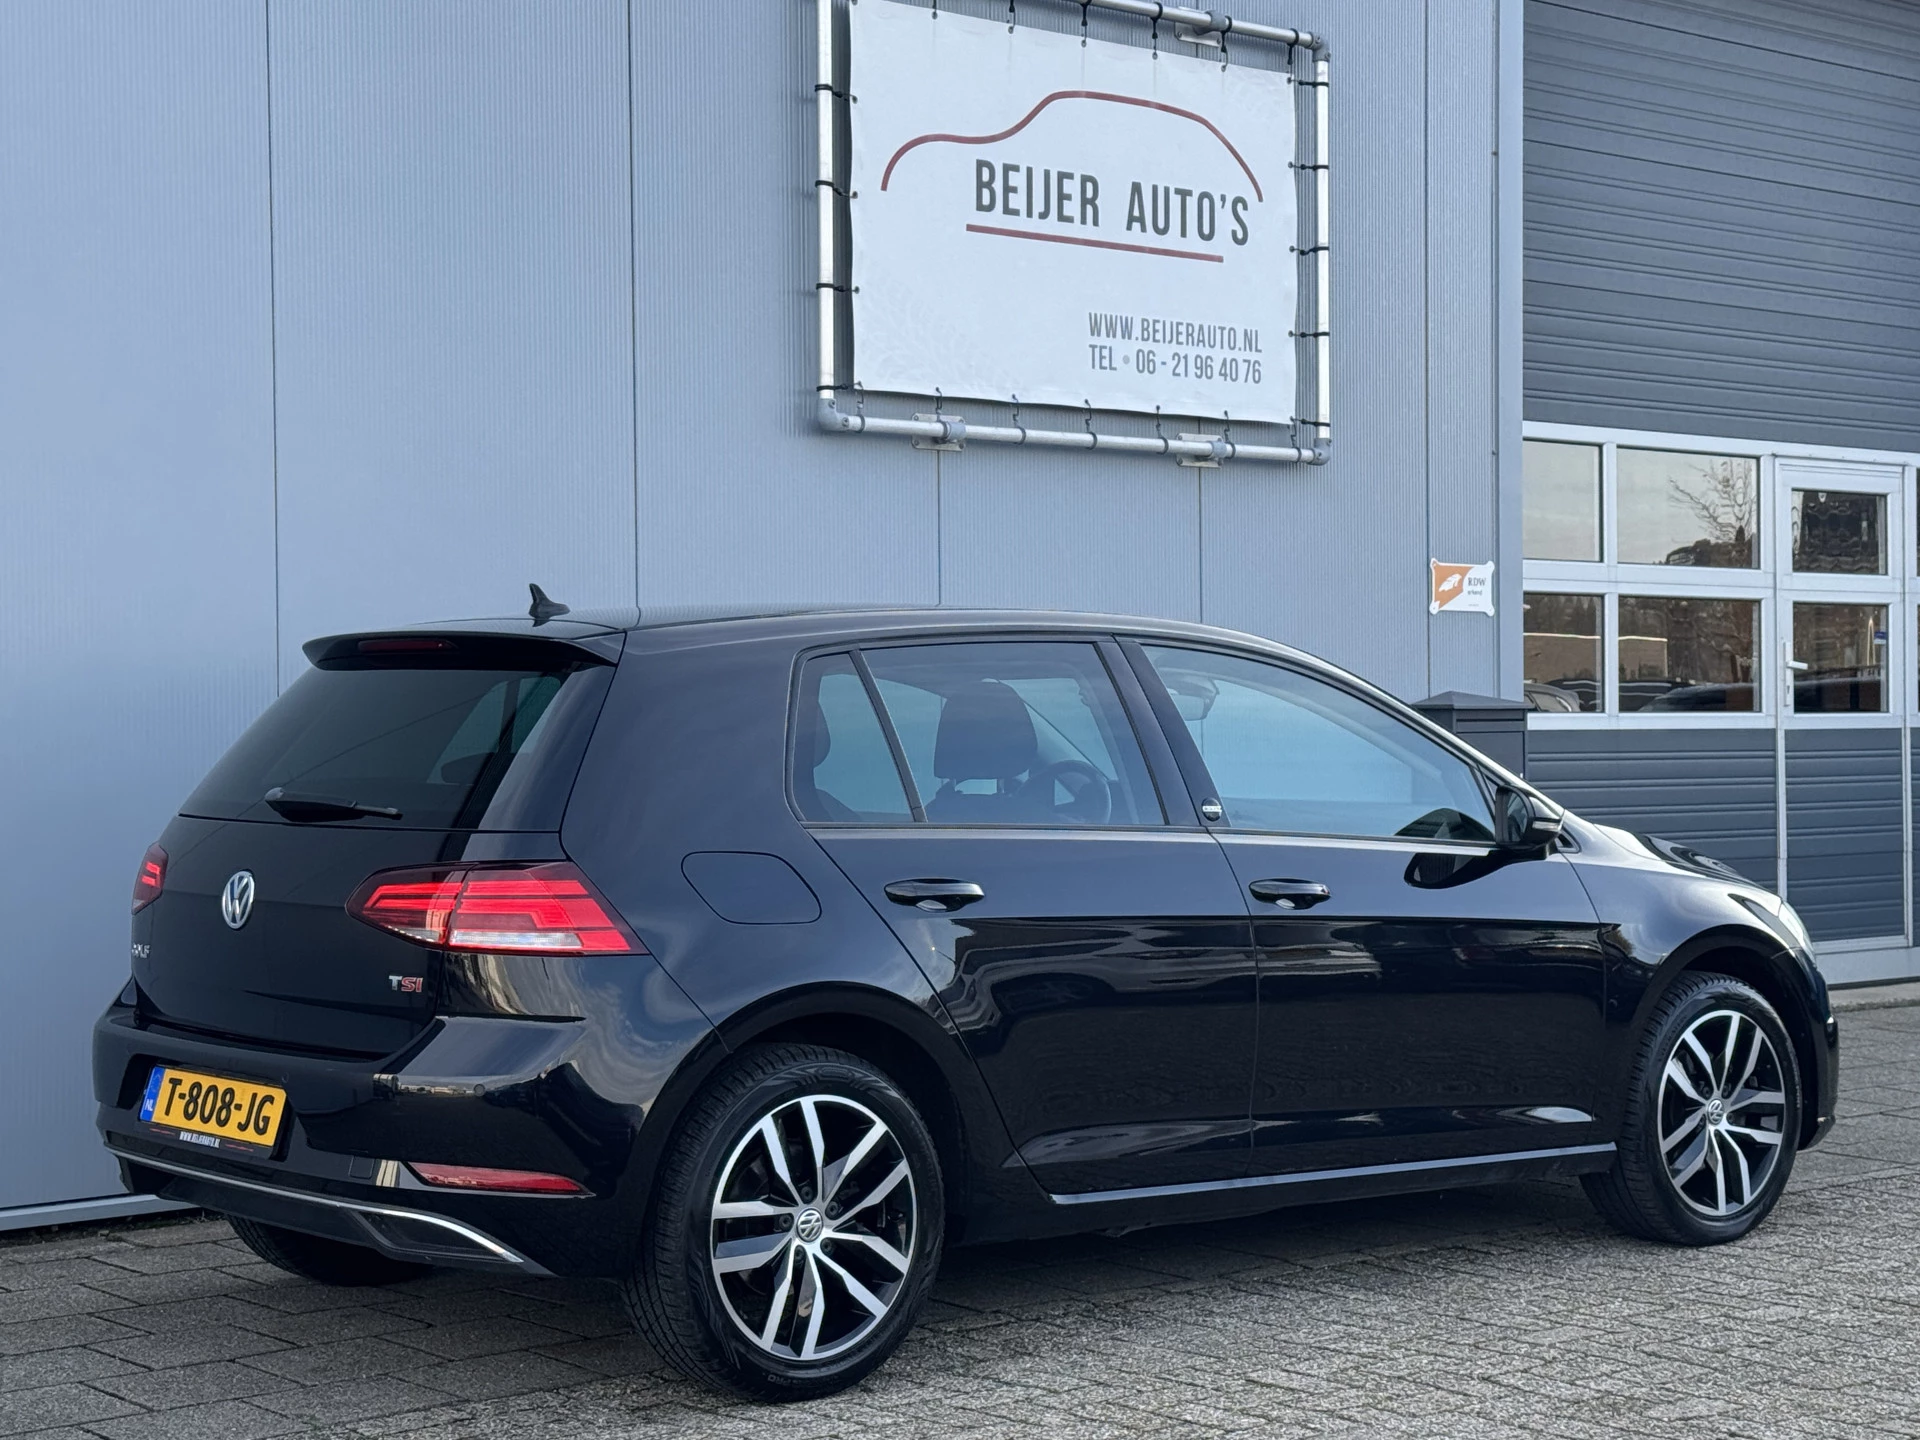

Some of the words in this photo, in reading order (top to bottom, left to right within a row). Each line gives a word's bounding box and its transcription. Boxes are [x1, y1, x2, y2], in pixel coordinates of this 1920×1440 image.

[975, 158, 1100, 227] BEIJER
[1126, 181, 1249, 246] AUTO'S
[1088, 312, 1263, 353] WWW.BEIJERAUTO.NL
[1088, 344, 1117, 371] TEL
[1135, 349, 1156, 375] 06
[1171, 352, 1188, 378] 21
[1194, 354, 1214, 380] 96
[1218, 357, 1239, 382] 40
[1242, 359, 1262, 384] 76
[388, 975, 424, 993] TSI
[145, 1098, 154, 1112] NL
[165, 1077, 275, 1136] T-808-JG
